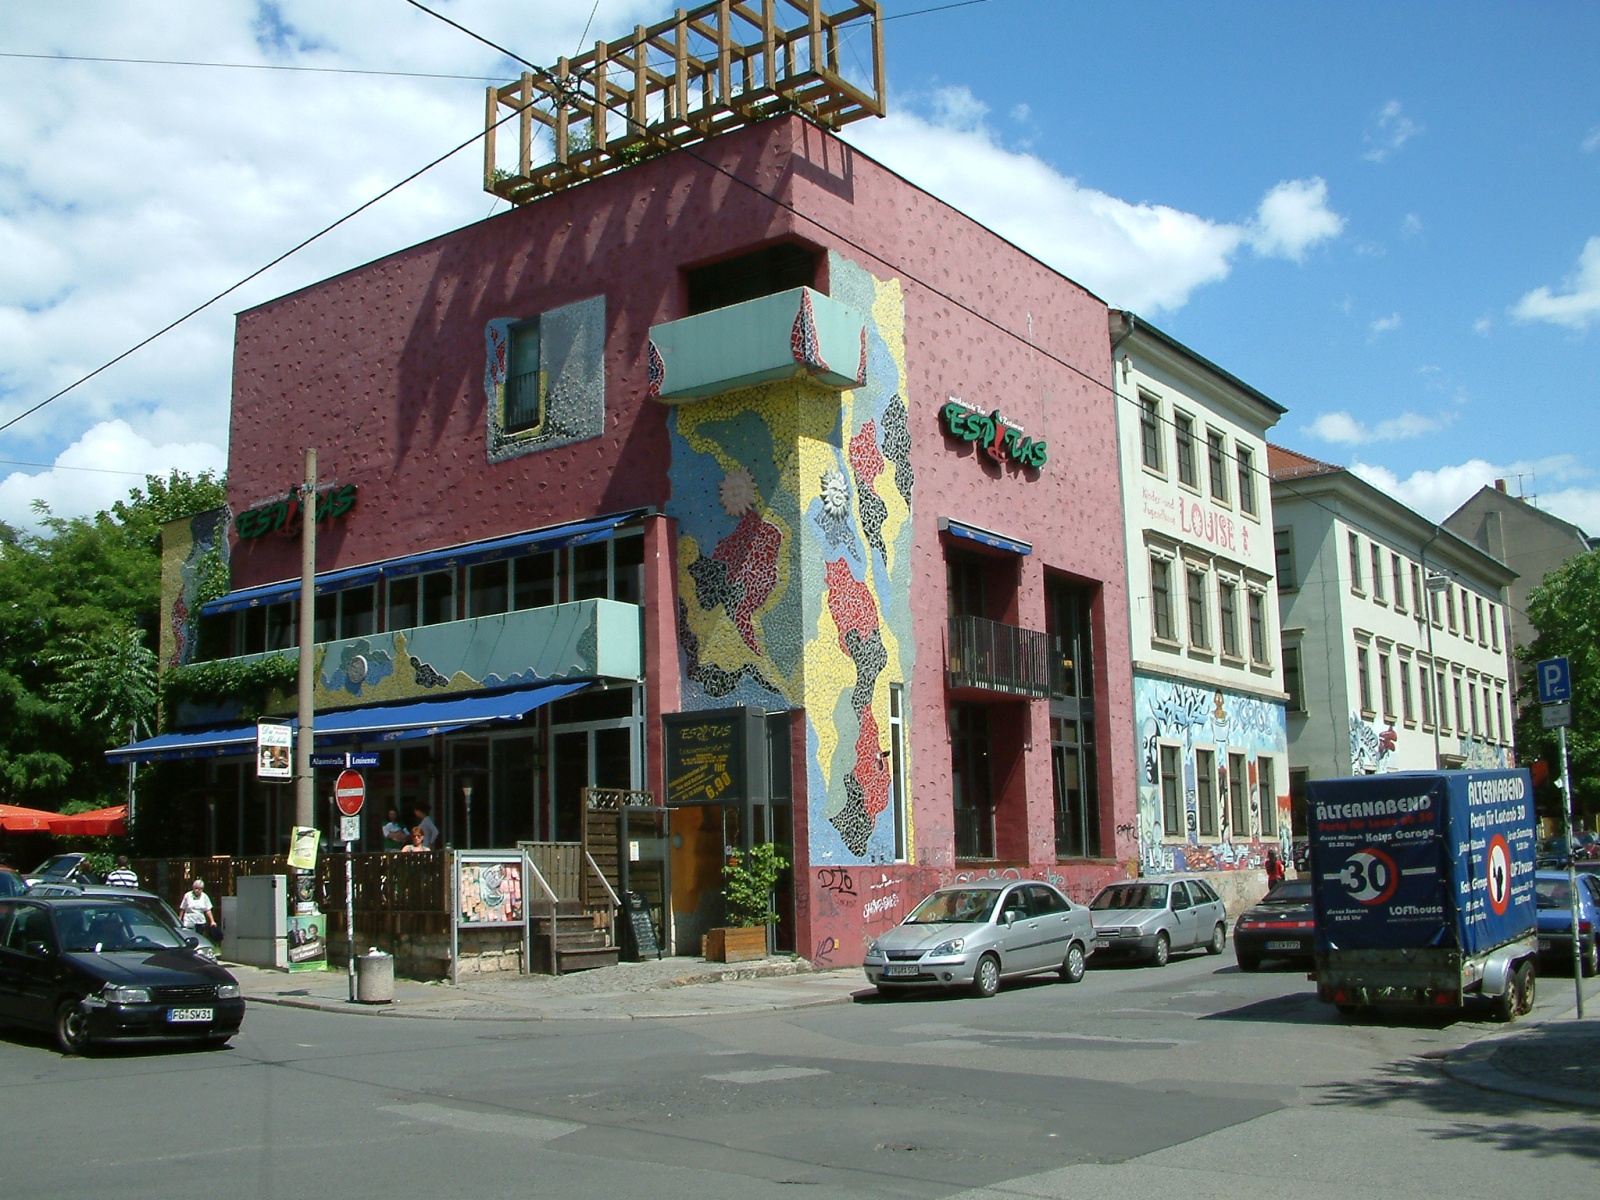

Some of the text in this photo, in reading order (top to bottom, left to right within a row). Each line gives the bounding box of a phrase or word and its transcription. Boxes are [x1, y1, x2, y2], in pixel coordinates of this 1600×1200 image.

[1179, 496, 1237, 552] LOUISE
[1544, 664, 1562, 697] P
[705, 771, 731, 799] 6,90
[1468, 775, 1524, 806] ÄLTERNABEND
[1316, 795, 1431, 820] ÄLTERNABEND
[1517, 805, 1526, 820] 30
[1395, 828, 1434, 840] Garage
[1339, 859, 1391, 894] 30
[1389, 905, 1443, 916] LOFThouse
[173, 1010, 184, 1019] FG
